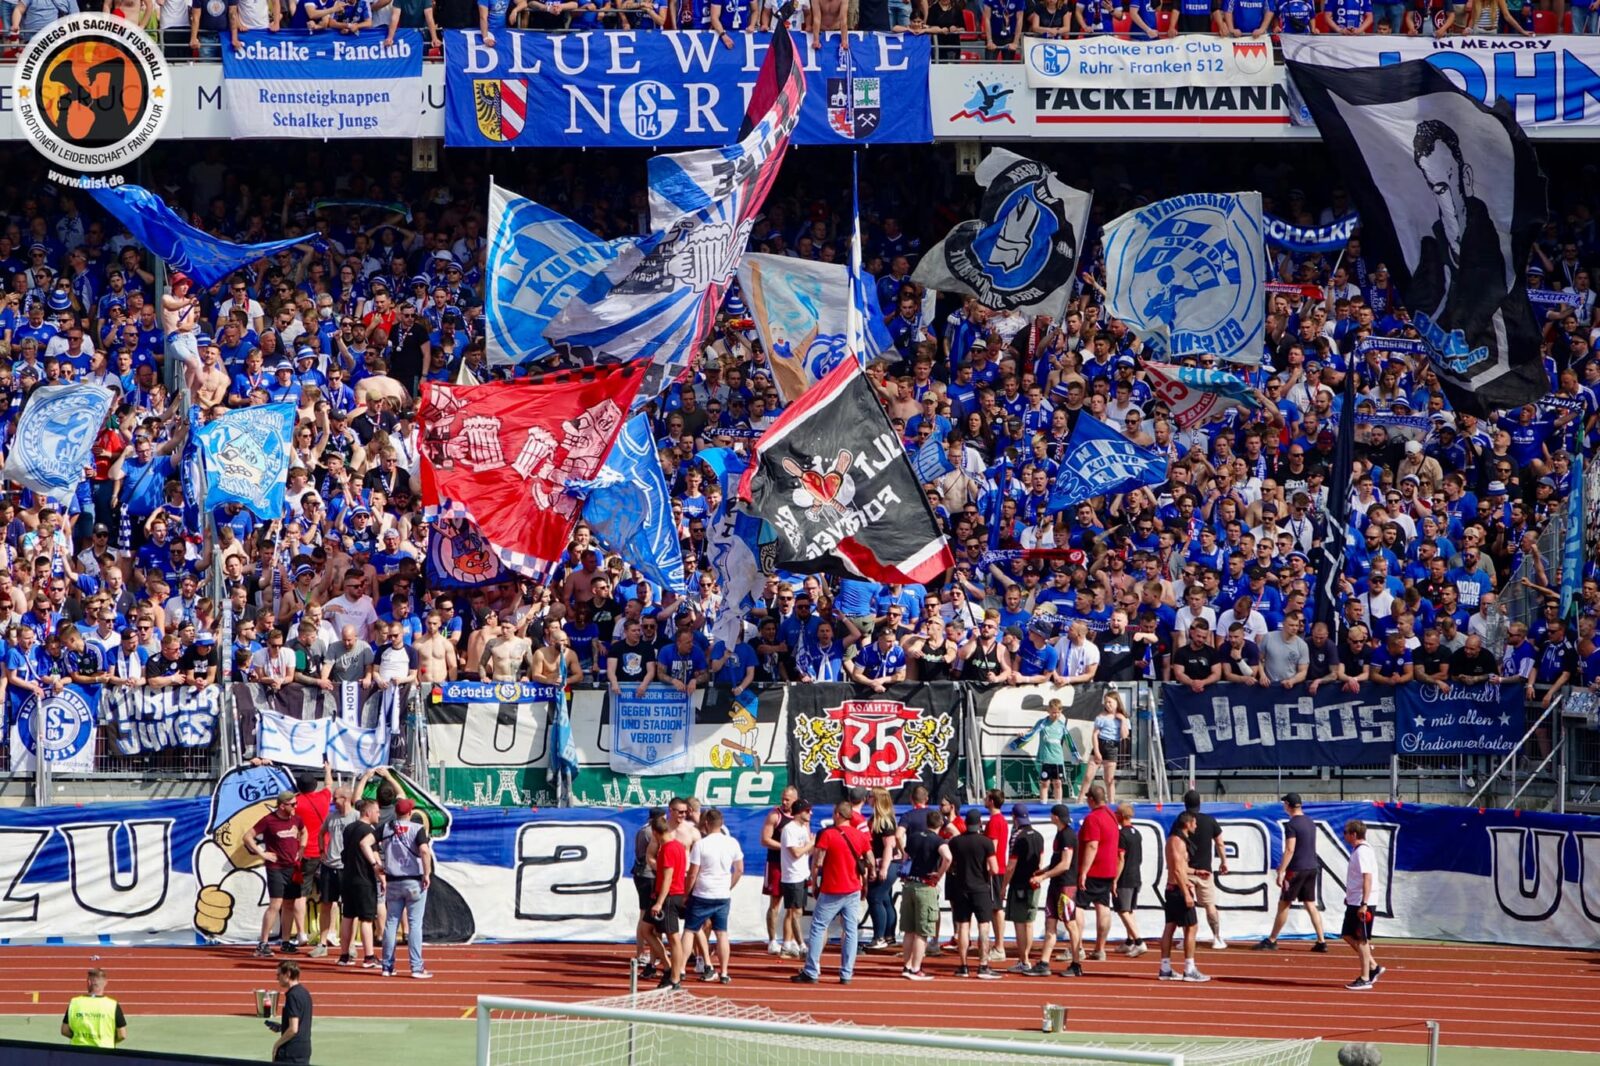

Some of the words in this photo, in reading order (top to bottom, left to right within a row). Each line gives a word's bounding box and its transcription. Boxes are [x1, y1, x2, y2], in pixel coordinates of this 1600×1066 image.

[234, 41, 310, 62] Schalke
[333, 38, 411, 61] Fanclub
[462, 30, 641, 75] BLUE
[1186, 42, 1223, 54] Club
[1432, 40, 1452, 50] IN
[1461, 39, 1552, 50] MEMORY
[1079, 60, 1113, 75] Ruhr
[1131, 60, 1192, 74] Franken
[1196, 59, 1224, 72] 512
[259, 88, 390, 107] Rennsteigknappen
[1036, 86, 1290, 110] FACKELMANN
[272, 112, 332, 129] Schalker
[337, 112, 379, 130] Jungs
[101, 684, 221, 721] MARLER
[638, 691, 662, 700] ERDEN
[621, 705, 651, 717] GEGEN
[654, 705, 687, 717] STADT-
[1431, 713, 1455, 727] mit
[1458, 709, 1494, 726] allen
[116, 713, 214, 755] JUNGS
[621, 719, 641, 730] UND
[643, 719, 687, 731] STADION-
[1183, 696, 1395, 754] HUGOS
[631, 732, 673, 744] VERBOTE
[842, 718, 906, 773] 35
[514, 820, 625, 922] 2
